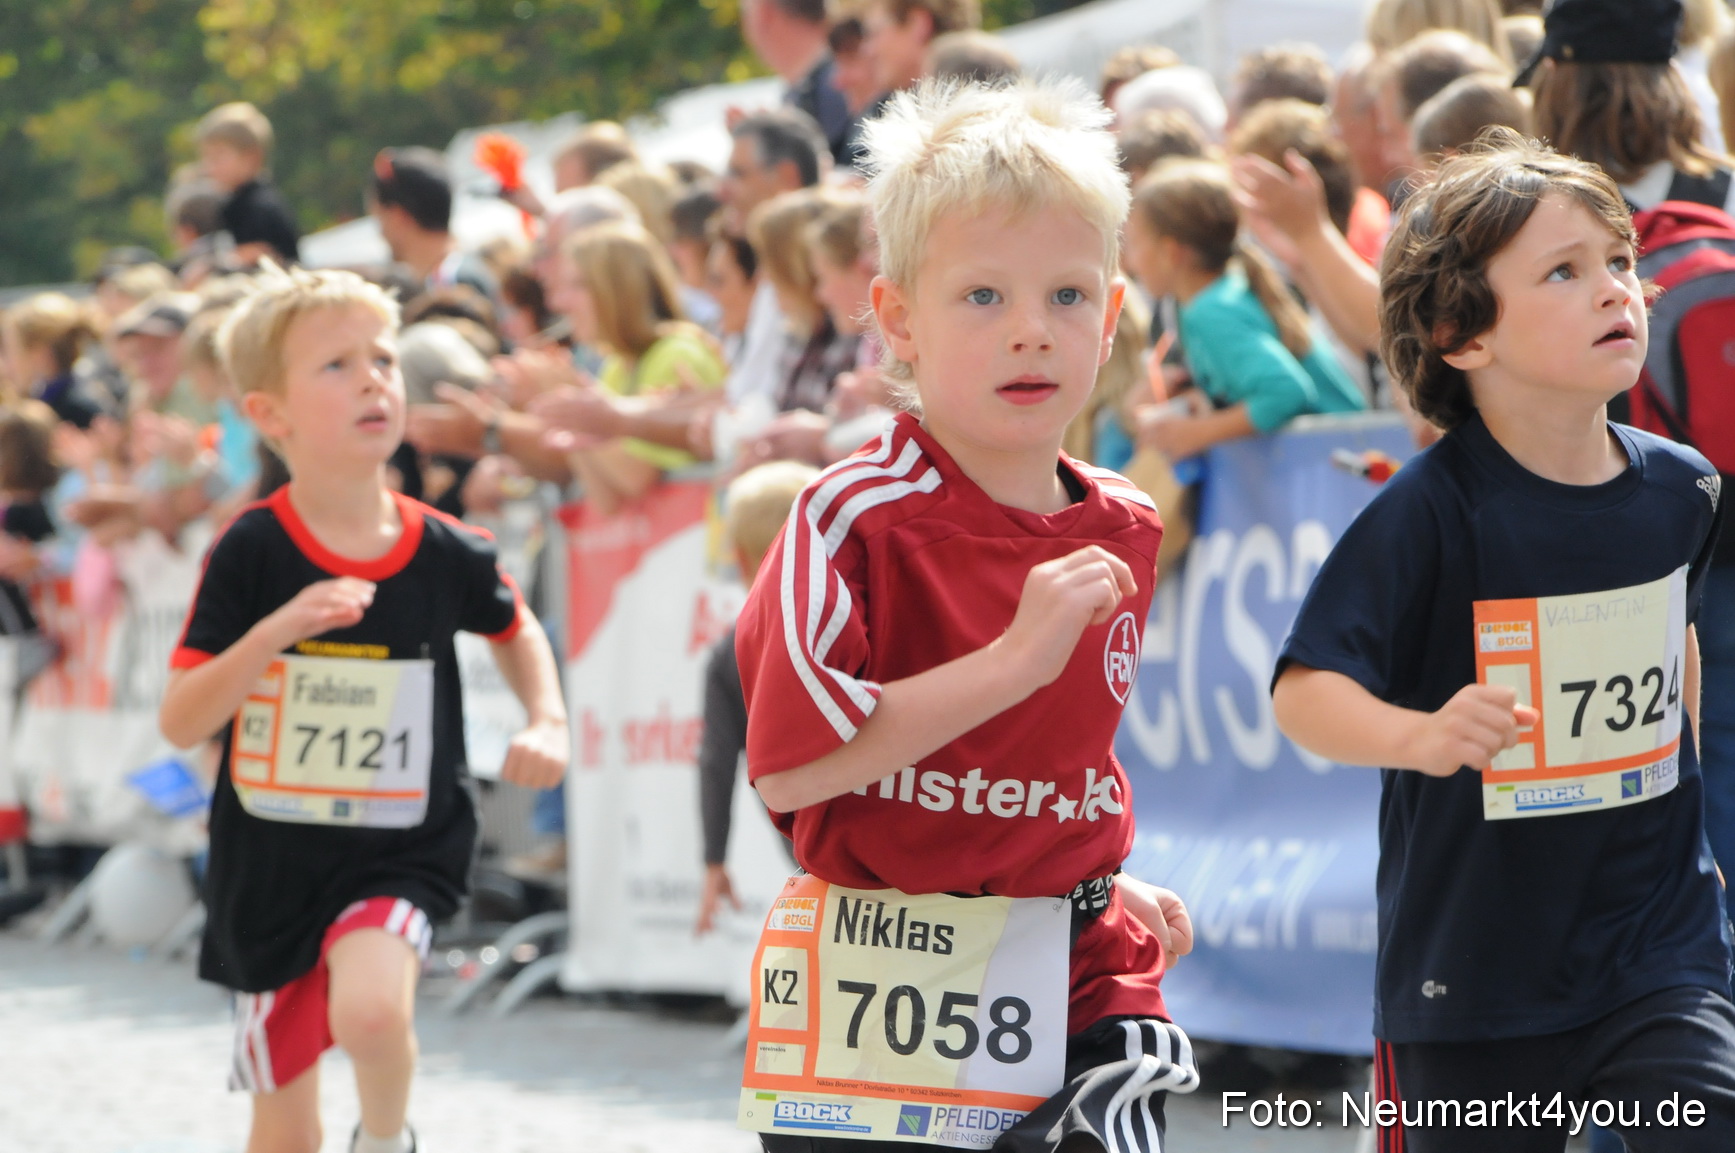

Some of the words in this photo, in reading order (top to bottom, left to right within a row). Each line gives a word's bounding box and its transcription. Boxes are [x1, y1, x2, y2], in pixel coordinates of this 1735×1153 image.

[1545, 596, 1646, 628] VALENTIN
[294, 673, 377, 706] Fabian
[1561, 654, 1679, 738] 7324
[295, 725, 411, 770] 7121
[1515, 784, 1585, 805] BOCK
[834, 896, 954, 955] Niklas
[764, 969, 798, 1005] K2
[837, 980, 1032, 1064] 7058
[774, 1101, 853, 1122] BOCK
